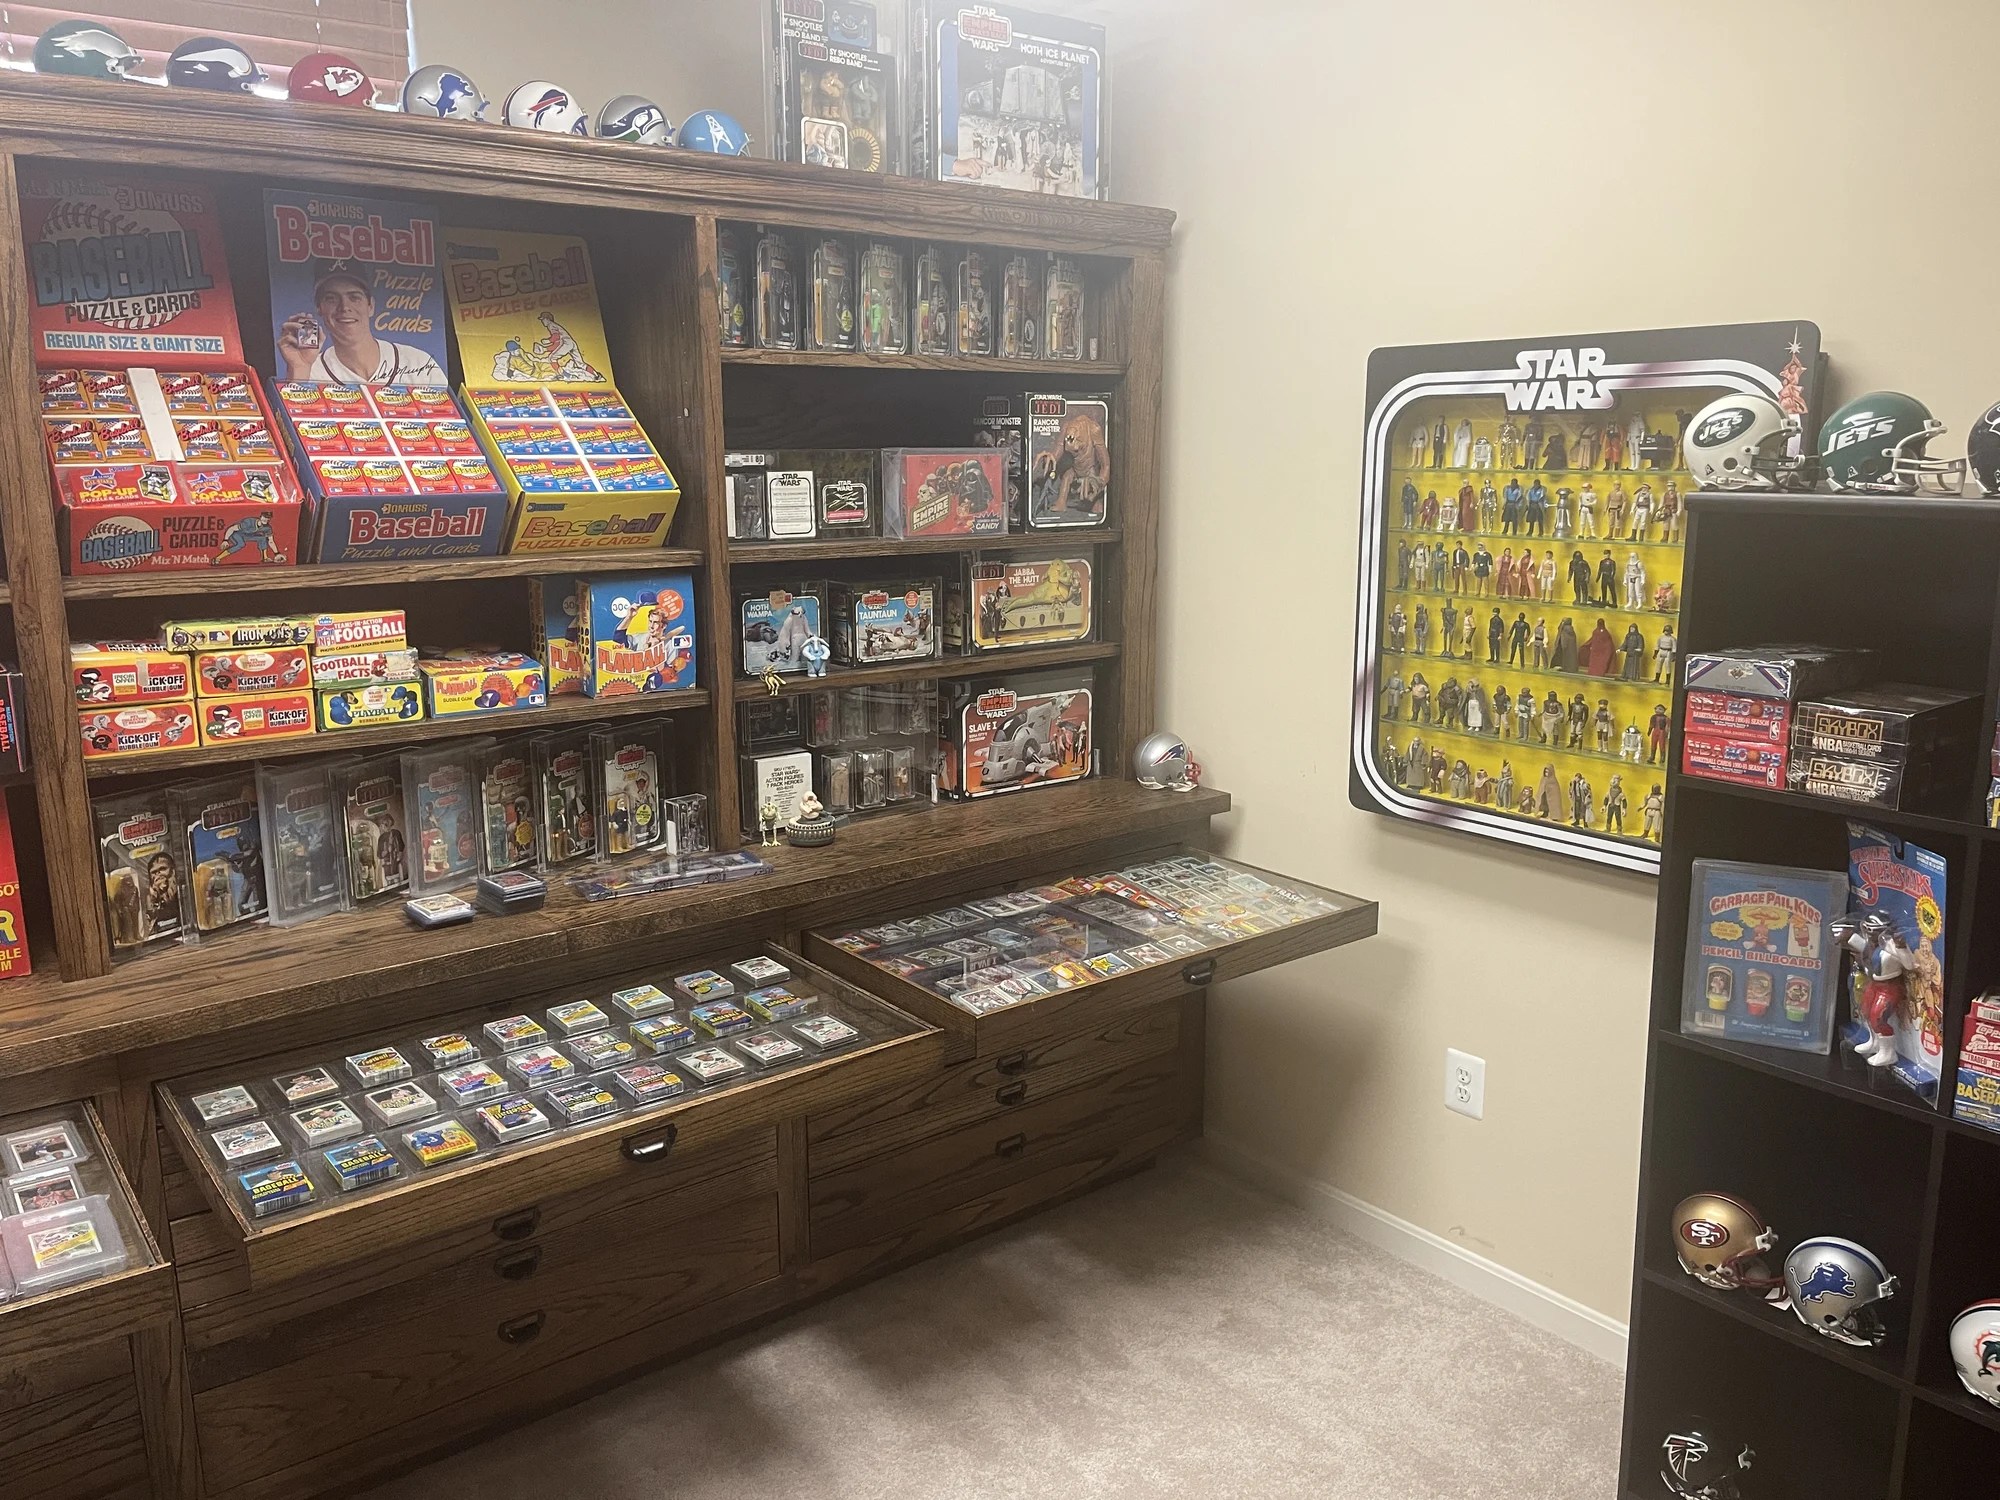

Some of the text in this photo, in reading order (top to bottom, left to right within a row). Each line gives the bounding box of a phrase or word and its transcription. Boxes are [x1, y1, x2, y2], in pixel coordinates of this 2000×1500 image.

[974, 5, 996, 17] STAR
[789, 18, 823, 32] SNOOTLES
[972, 39, 999, 52] WARS
[1020, 43, 1090, 65] HOTH ICE PLANET
[838, 49, 868, 62] SNOOTLES
[274, 205, 435, 267] Baseball
[29, 228, 215, 306] BASEBALL
[452, 247, 588, 304] Baseball
[373, 269, 434, 292] Puzzle
[64, 291, 202, 325] PUZZLE & CARDS
[386, 292, 424, 312] and
[460, 301, 521, 322] PUZZLE
[374, 312, 433, 333] Cards
[46, 333, 223, 353] REGULAR SIZE & GIANT SIZE
[1516, 347, 1606, 380] STAR
[1503, 378, 1614, 411] WARS
[1034, 402, 1061, 414] JEDI
[996, 417, 1022, 426] MONSTER
[1822, 415, 1897, 456] JETS
[79, 488, 138, 500] POP-UP
[381, 503, 428, 516] DONRUSS
[913, 499, 949, 524] EMPIRE
[163, 516, 225, 533] PUZZLE &
[348, 507, 487, 545] Baseball
[522, 513, 666, 539] Baseball
[975, 522, 1000, 530] CANDY
[81, 529, 163, 564] BASEBALL
[170, 533, 219, 549] CARDS
[517, 535, 651, 551] PUZZLE & CARDS
[152, 554, 210, 565] Mix Match
[341, 542, 480, 560] Puzzle and Cards
[1008, 575, 1040, 585] THE HUTT
[1013, 568, 1036, 577] JABBA
[750, 604, 769, 612] HOTH
[858, 611, 898, 620] TAUNTAUN
[335, 621, 406, 642] FOOTBALL
[313, 656, 370, 674] FOOTBALL
[597, 641, 667, 674] PLAYBALL
[337, 668, 370, 680] FACTS
[988, 688, 1006, 696] STAR
[351, 707, 399, 718] PLAYBALL
[985, 710, 1007, 718] WARS
[1693, 711, 1769, 726] BASKETBALL CARDS SEASON
[968, 721, 997, 733] SLAVE I
[1818, 717, 1878, 740] SKYBOX
[1819, 737, 1843, 753] NBA
[1690, 755, 1766, 772] BASKETBALL CARDS SEASON
[1813, 762, 1875, 786] SKYBOX
[1812, 782, 1837, 797] NBA
[130, 813, 151, 822] STAR
[131, 836, 158, 847] WARS
[1710, 892, 1821, 923] GARBAGE PAIL KIDS
[1702, 945, 1821, 970] PENCIL BILLBOARDS
[341, 1150, 384, 1169] BASEBALL
[253, 1175, 299, 1195] BASEBALL
